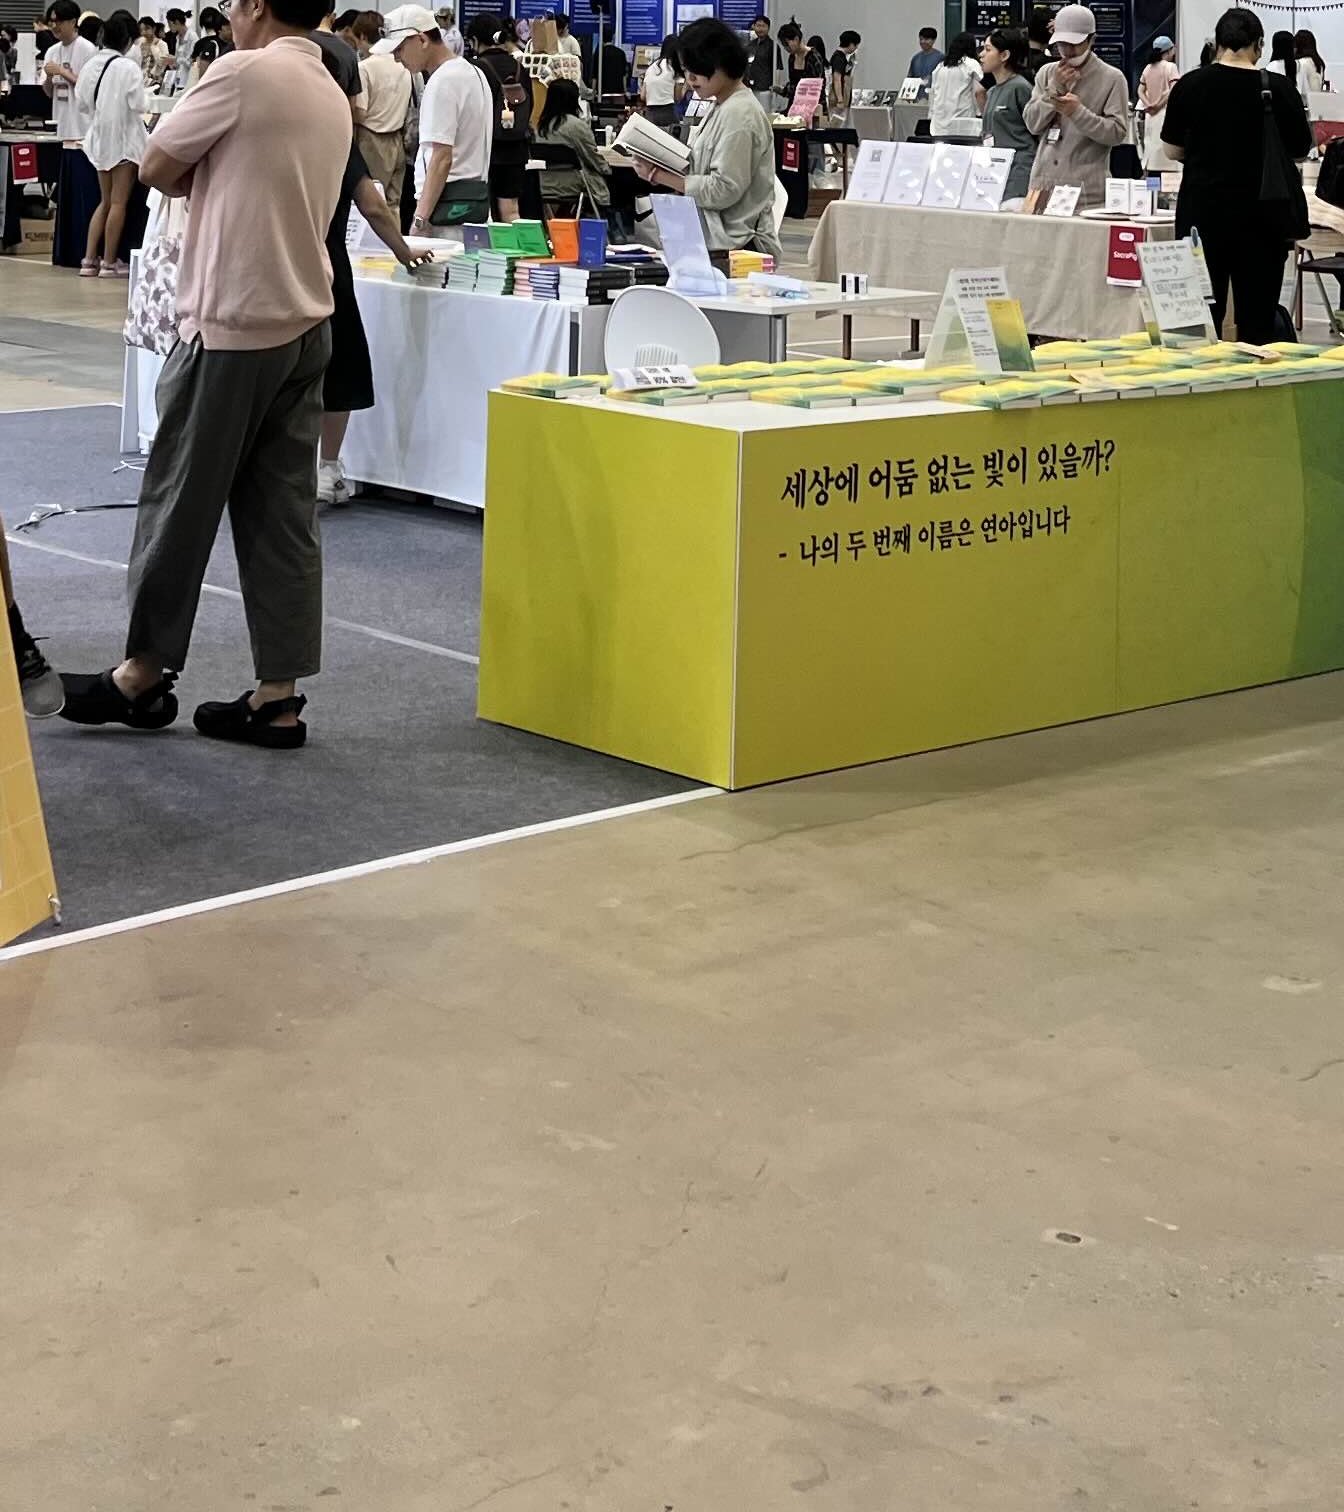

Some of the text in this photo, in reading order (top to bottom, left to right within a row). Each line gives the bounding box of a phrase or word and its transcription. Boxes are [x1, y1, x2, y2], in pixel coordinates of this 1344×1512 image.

[781, 439, 1116, 509] 세상에 어둠 없는 빛이 있을까?
[800, 531, 840, 567] 나의
[846, 529, 867, 561] 두
[872, 524, 911, 557] 번째
[918, 517, 975, 552] 이름은
[980, 504, 1071, 544] 연아입니다
